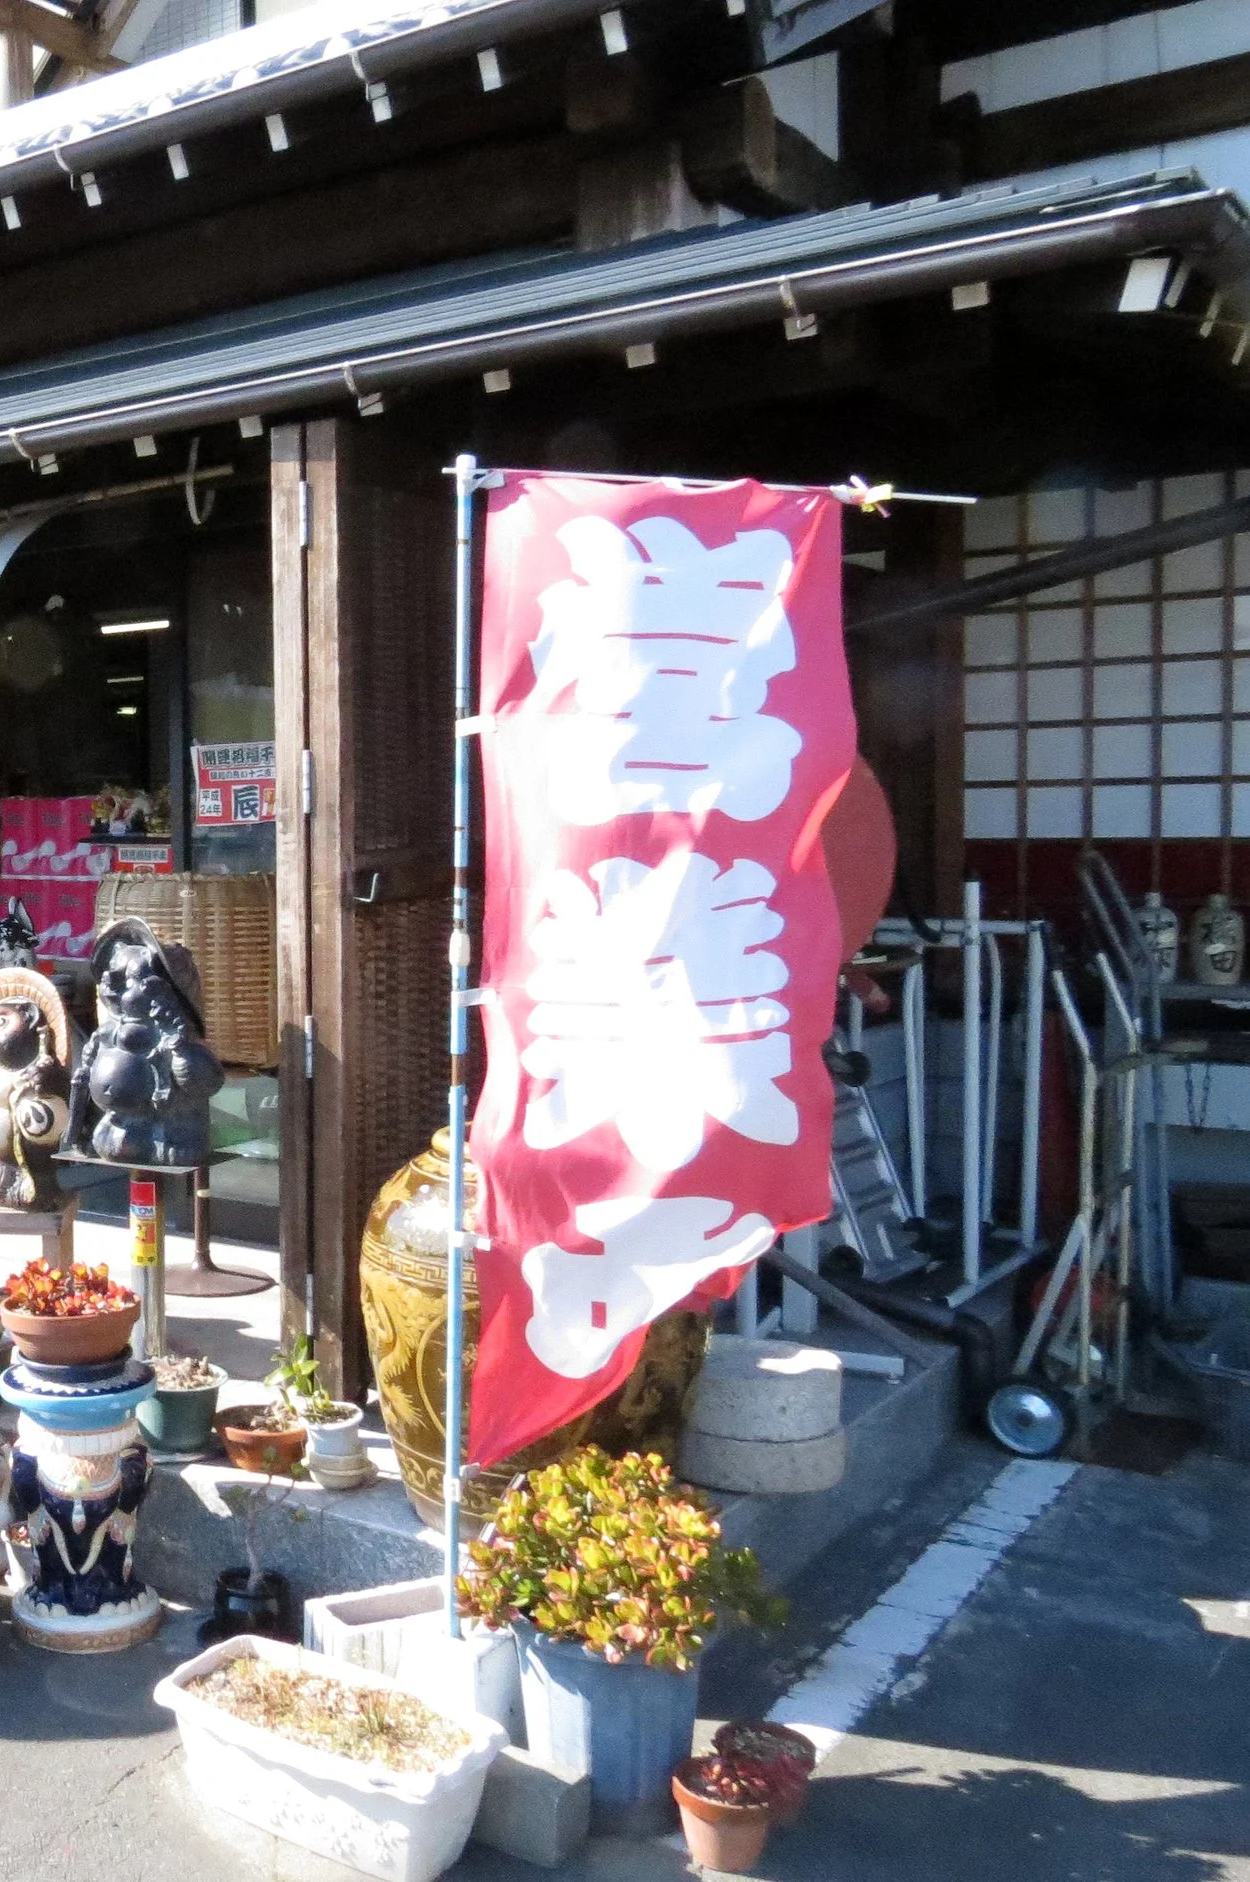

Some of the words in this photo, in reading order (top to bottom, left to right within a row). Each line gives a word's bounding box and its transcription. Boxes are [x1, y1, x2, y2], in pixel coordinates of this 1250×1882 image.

[200, 804, 221, 815] 24年
[233, 785, 259, 820] 辰
[520, 514, 802, 1380] 営業中
